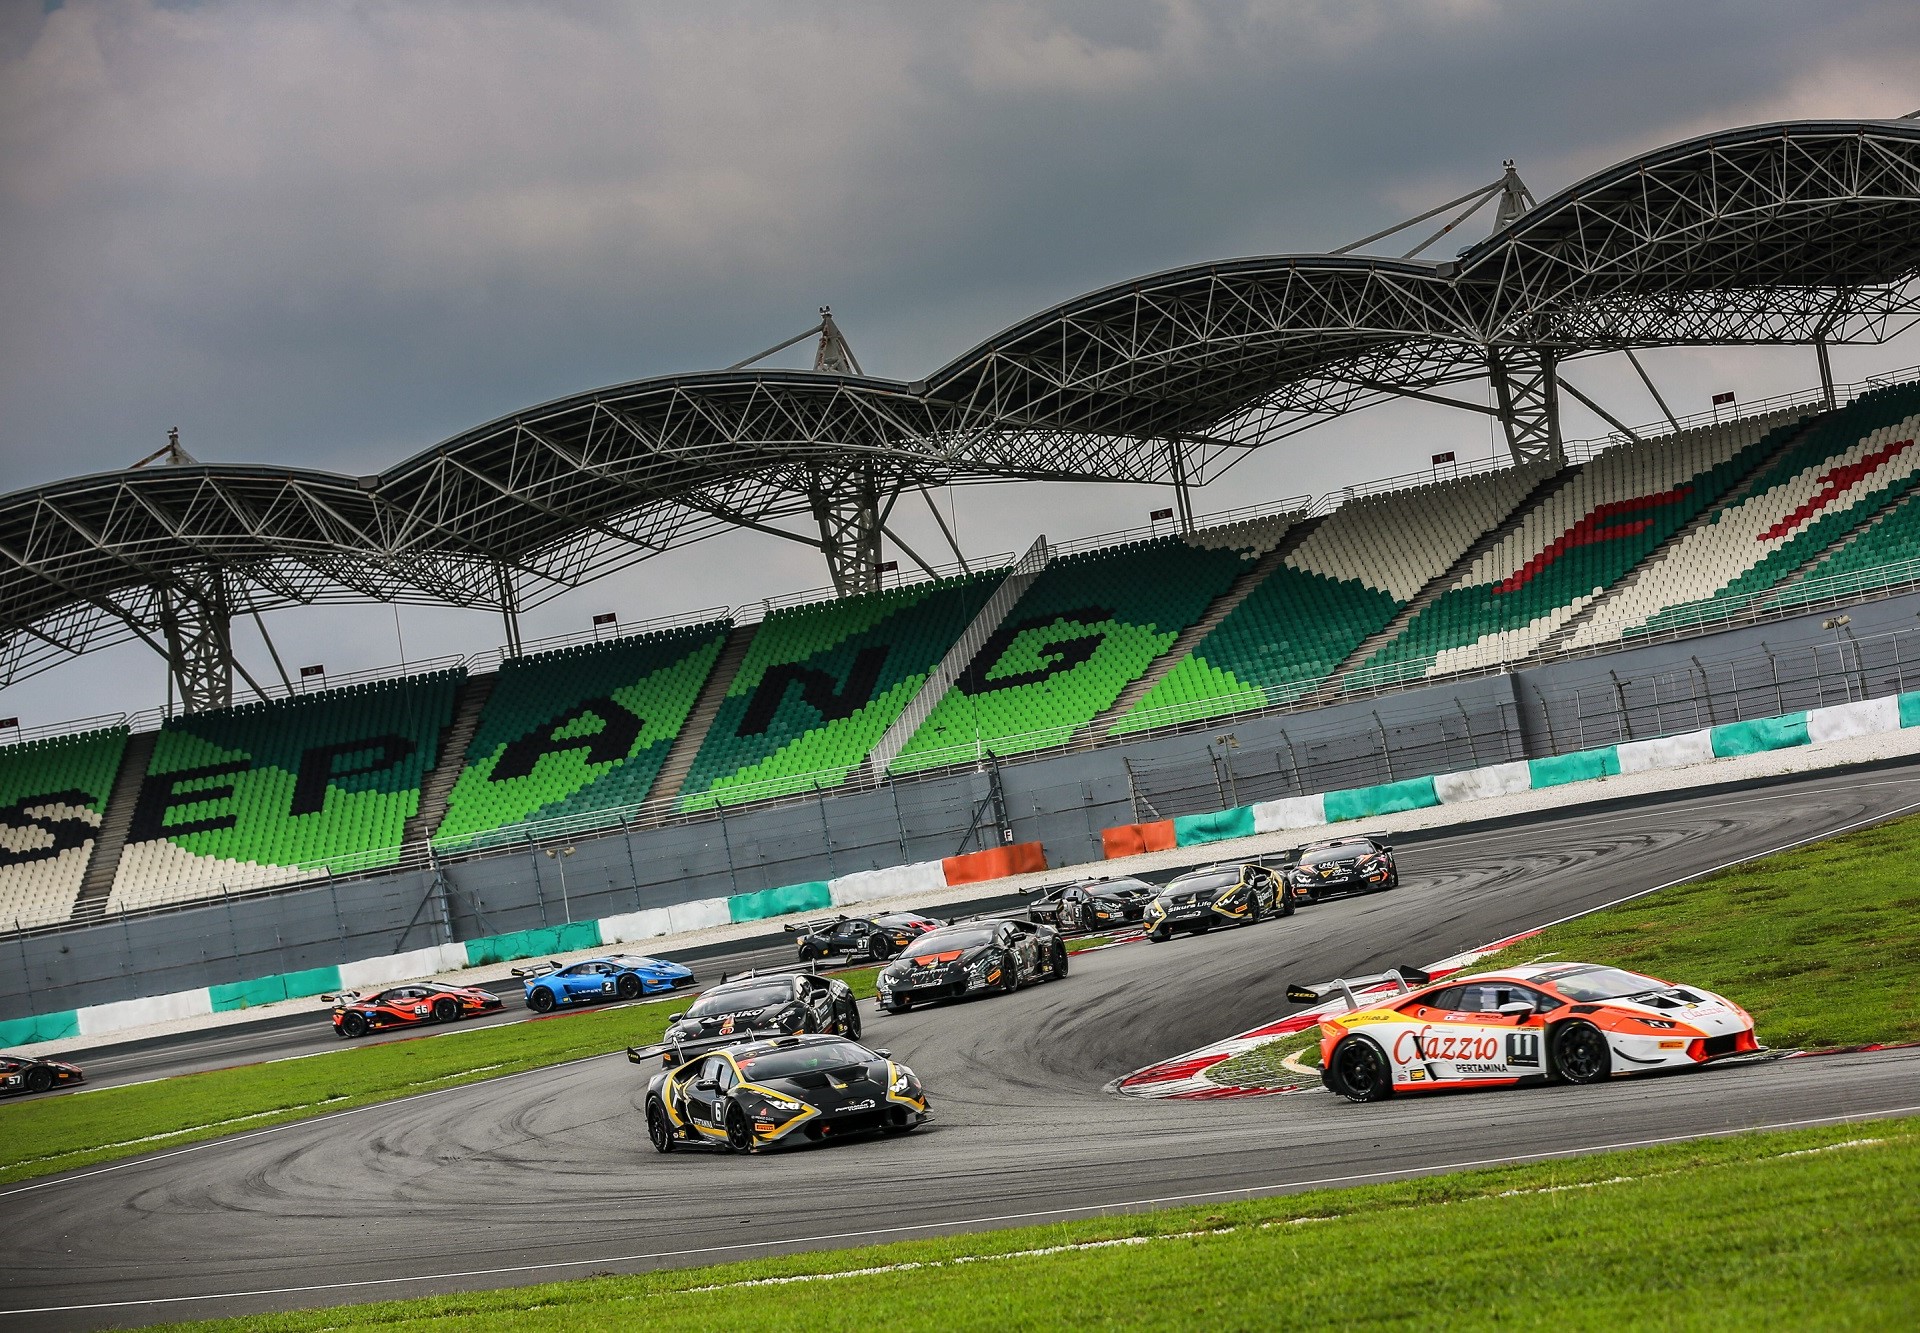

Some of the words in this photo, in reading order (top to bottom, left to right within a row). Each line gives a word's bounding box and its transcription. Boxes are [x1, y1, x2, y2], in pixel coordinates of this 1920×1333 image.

[1720, 394, 1727, 403] J
[1439, 453, 1447, 463] H
[1157, 510, 1166, 519] G
[1005, 830, 1011, 840] F
[857, 939, 868, 949] 37
[605, 982, 612, 991] 2
[414, 1005, 428, 1015] 66
[716, 1009, 764, 1021] DAIKO
[1393, 1024, 1498, 1066] Clazzio
[1512, 1034, 1533, 1056] 11
[1455, 1063, 1509, 1073] PERTAMINA
[8, 1075, 21, 1085] 57
[715, 1102, 721, 1122] 6
